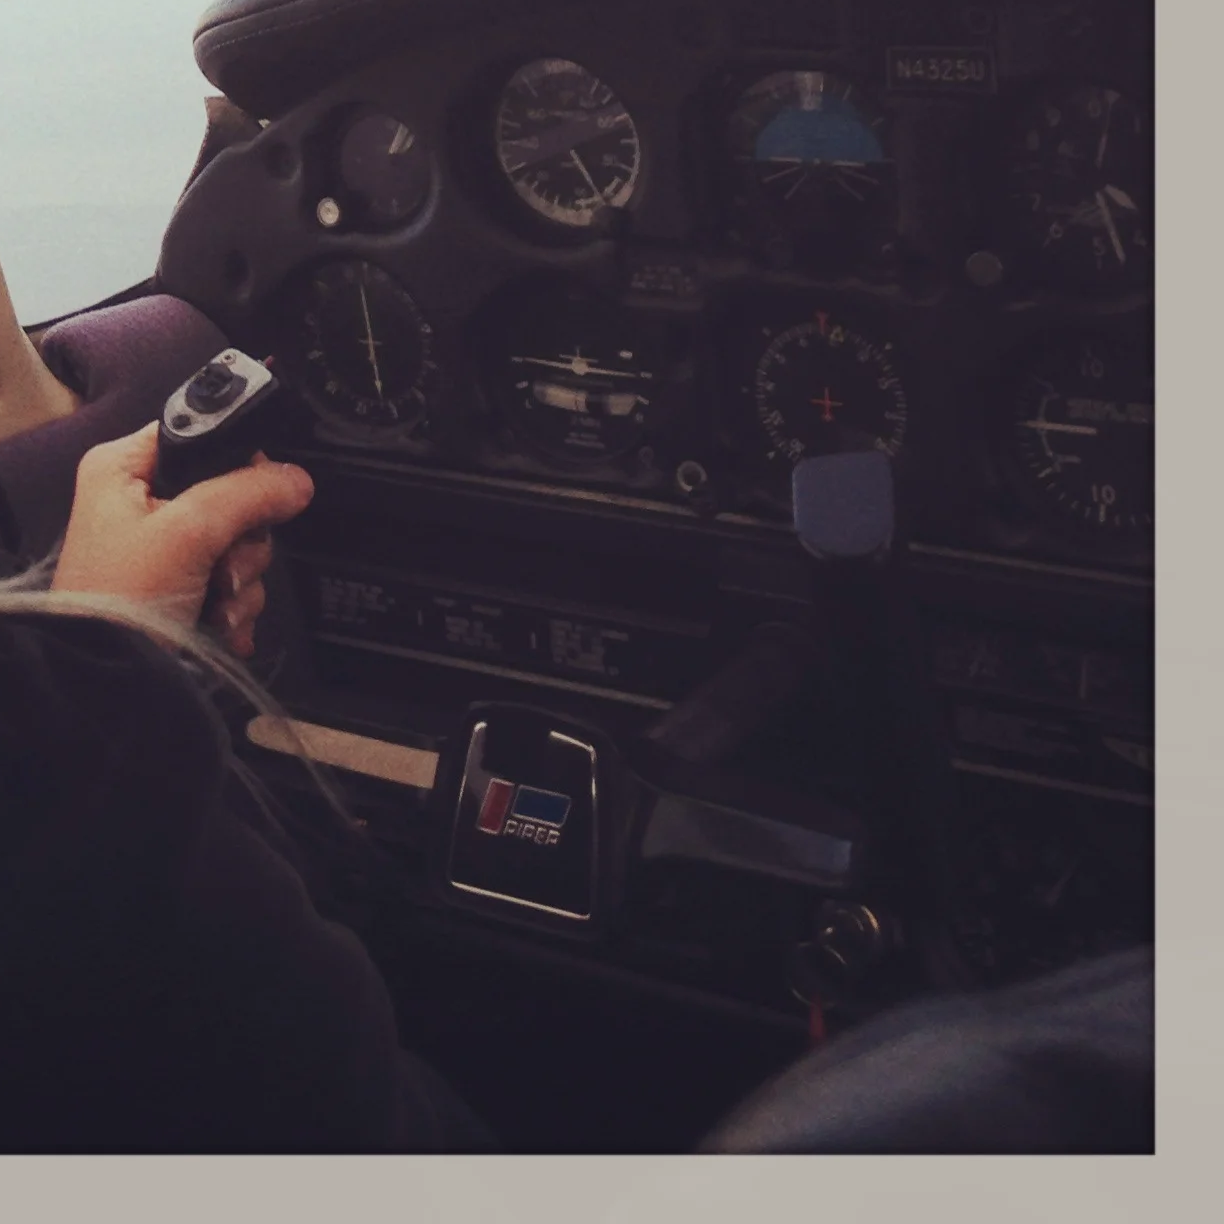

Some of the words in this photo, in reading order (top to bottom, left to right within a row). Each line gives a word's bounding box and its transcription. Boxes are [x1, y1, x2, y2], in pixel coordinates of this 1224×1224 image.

[895, 56, 985, 82] N4325U
[1091, 484, 1116, 504] 10
[503, 819, 561, 845] PIPER
